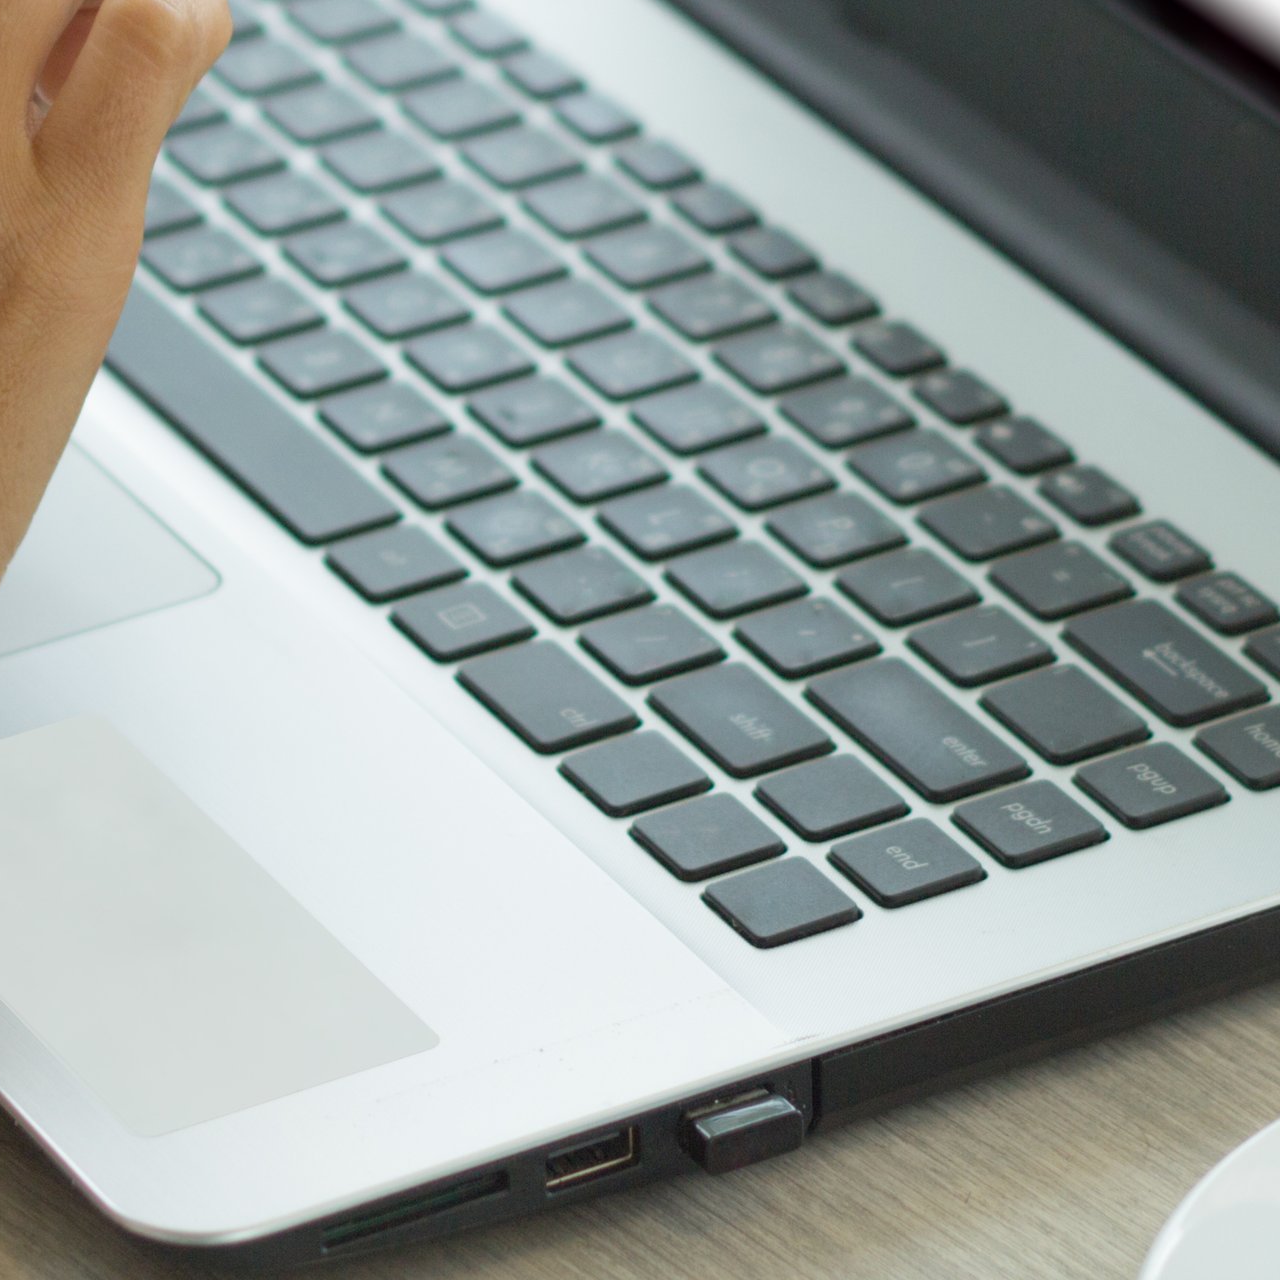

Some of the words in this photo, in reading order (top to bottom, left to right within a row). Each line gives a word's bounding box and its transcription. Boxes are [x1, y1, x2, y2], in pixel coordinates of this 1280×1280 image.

[560, 708, 598, 728] ctrl
[729, 713, 774, 741] shift
[941, 734, 989, 768] enter
[1126, 762, 1178, 796] pgup
[999, 801, 1054, 836] pgdn
[884, 844, 931, 872] end
